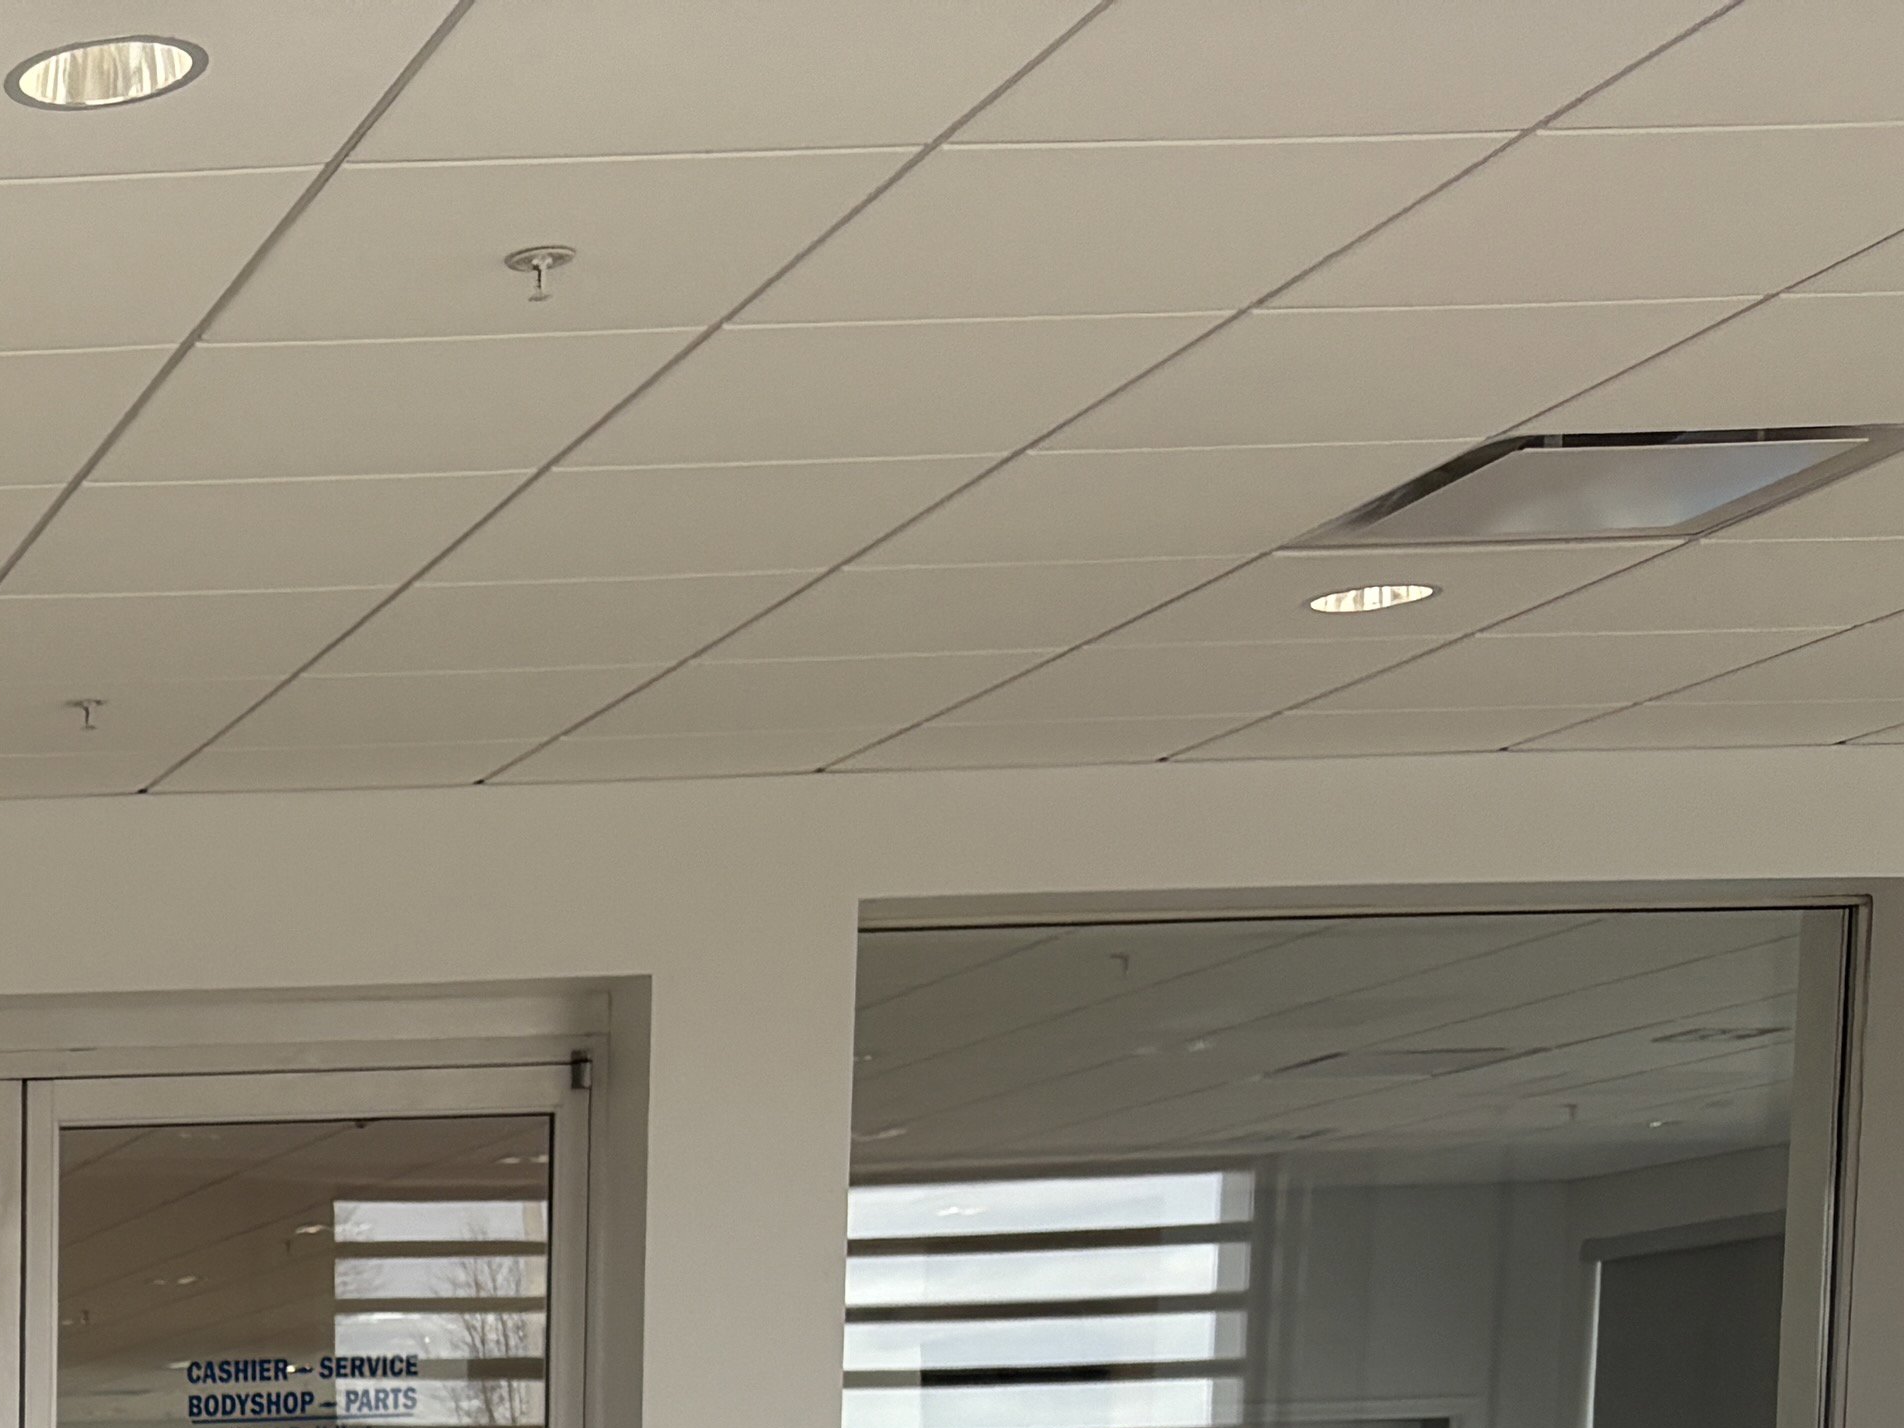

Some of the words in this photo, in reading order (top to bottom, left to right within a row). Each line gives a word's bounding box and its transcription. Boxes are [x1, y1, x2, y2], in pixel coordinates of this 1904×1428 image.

[187, 1359, 288, 1384] CASHIER
[319, 1354, 419, 1379] SERVICE
[188, 1391, 314, 1417] BODYSHOP
[344, 1387, 418, 1413] PARTS
